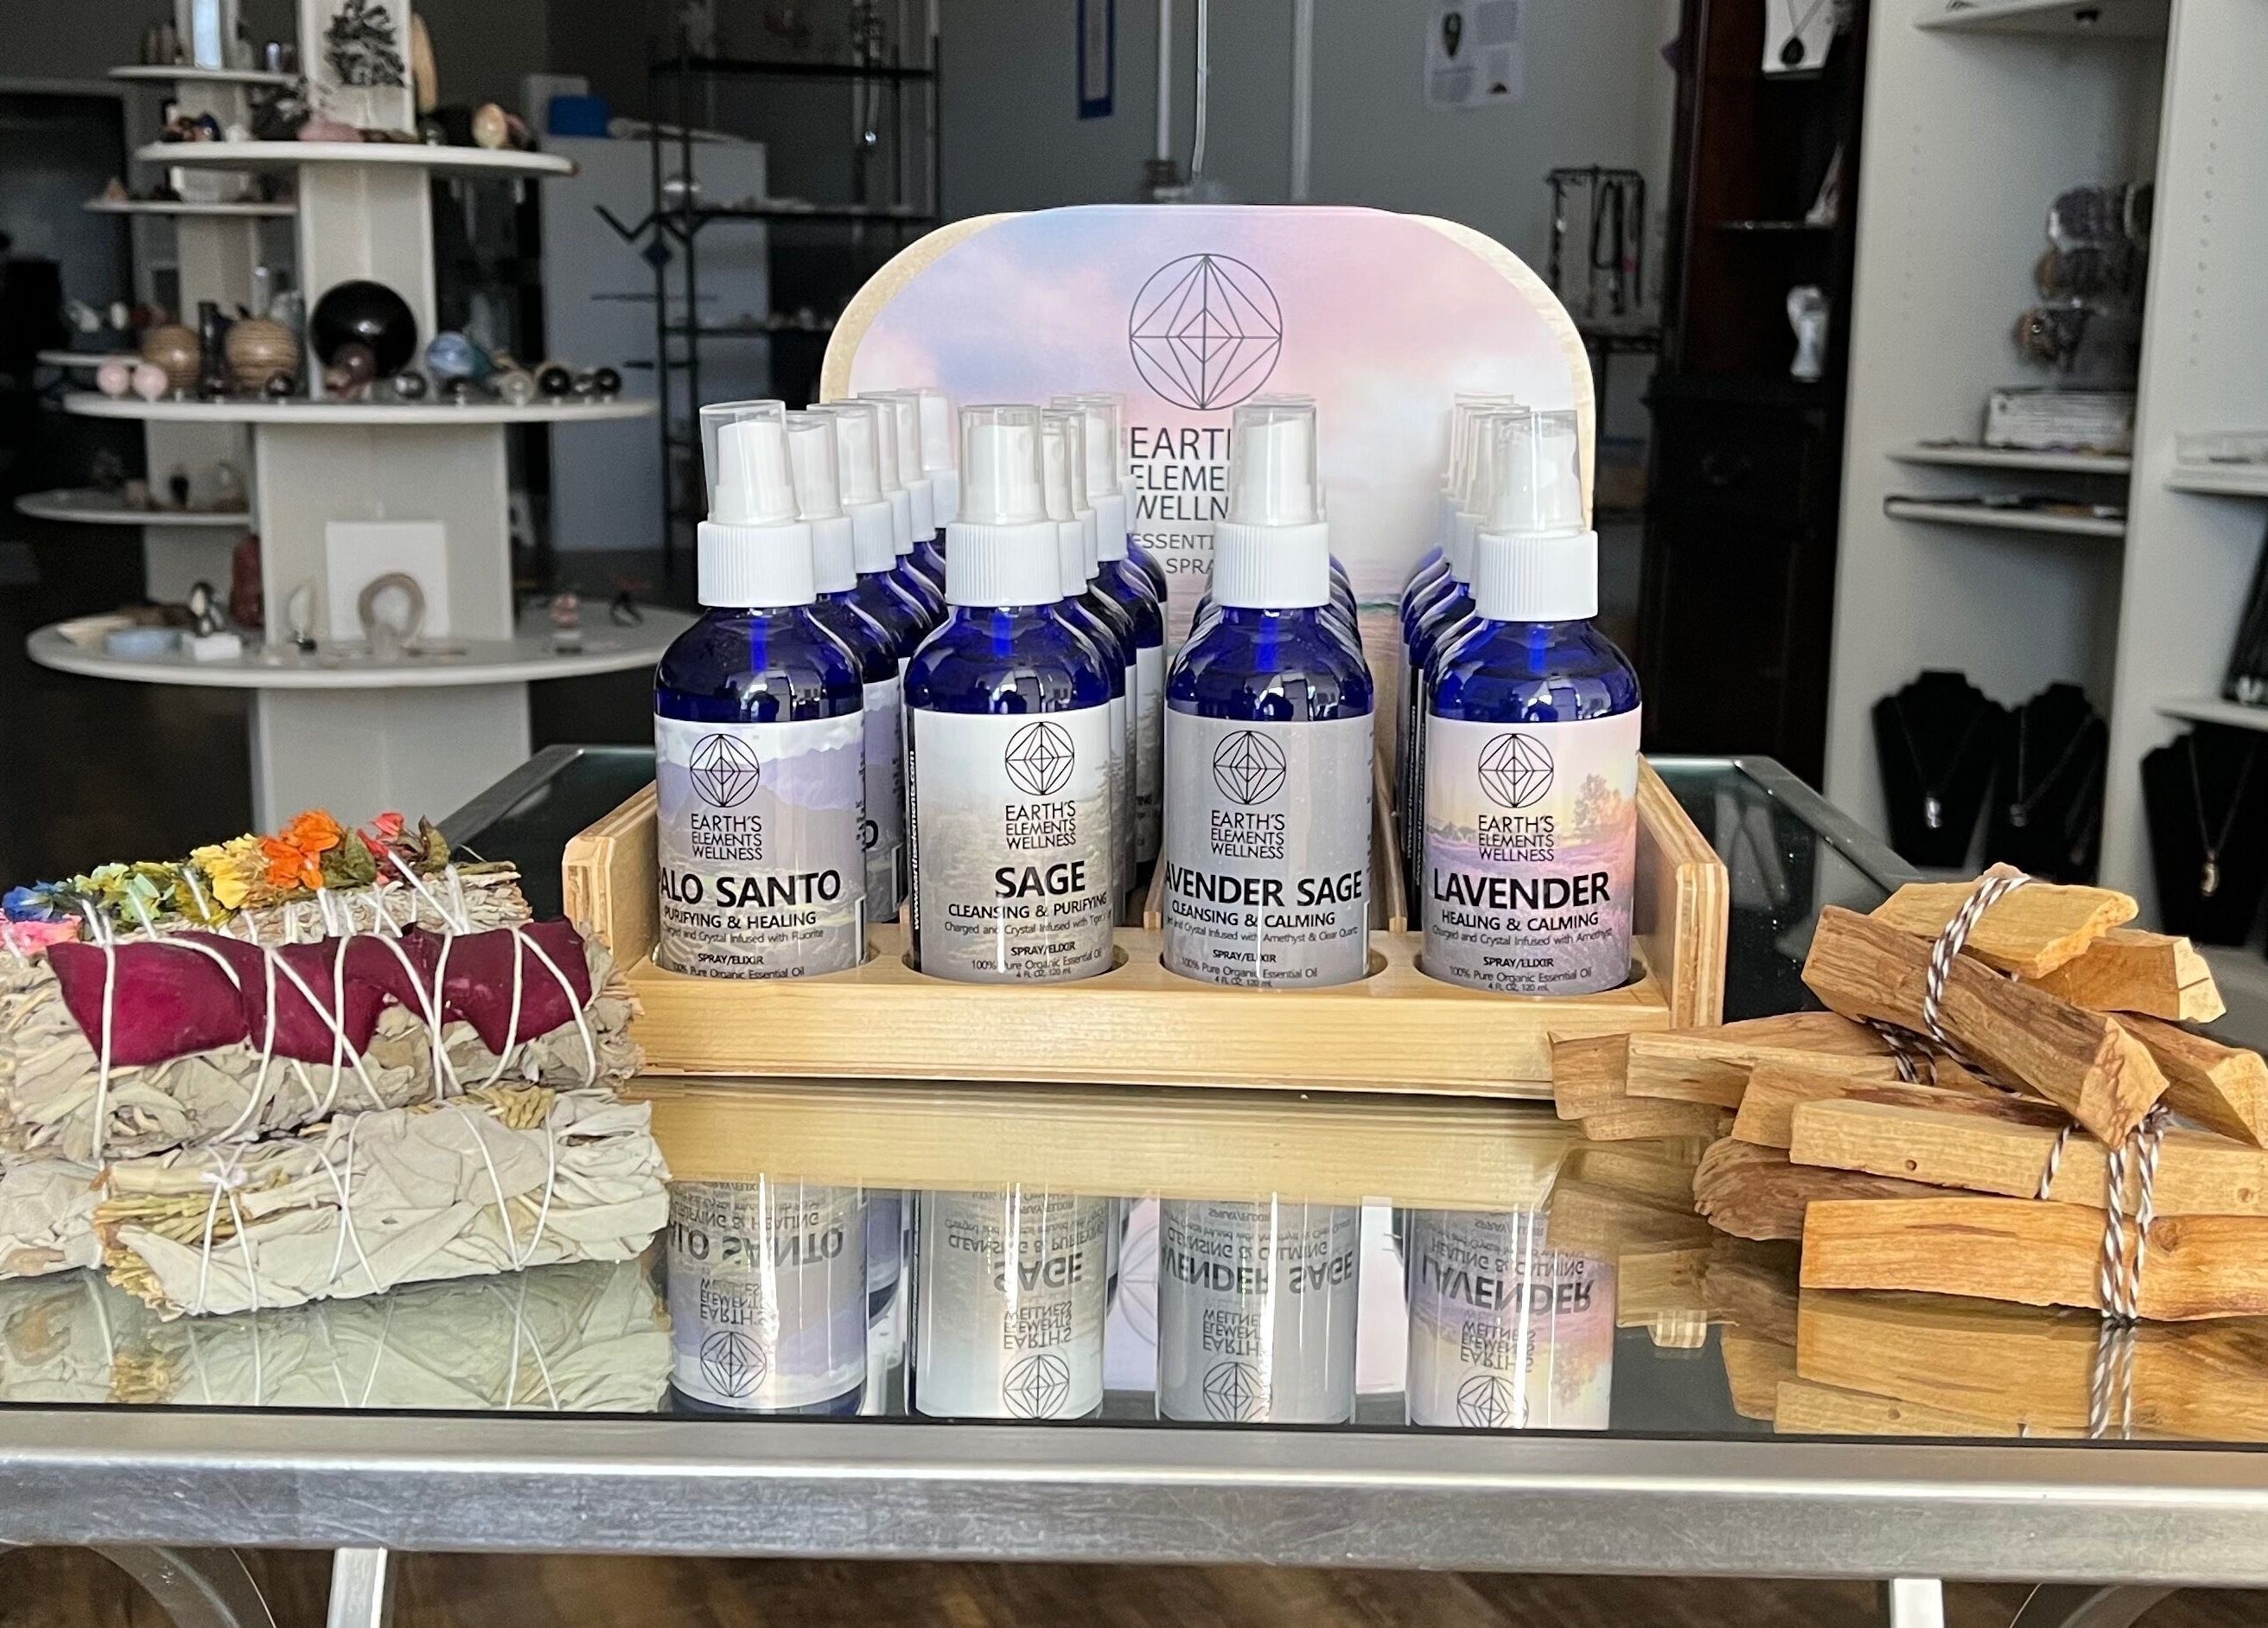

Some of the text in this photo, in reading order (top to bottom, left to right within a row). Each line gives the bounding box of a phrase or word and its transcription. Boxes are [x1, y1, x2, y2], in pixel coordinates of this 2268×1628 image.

[1131, 426, 1231, 461] EART
[1131, 464, 1229, 492] ELEME
[1005, 800, 1076, 821] EARTH'S
[691, 813, 762, 833] EARTH'S
[1005, 819, 1076, 836] ELEMENTS
[1211, 809, 1285, 832] EARTH'S
[1478, 814, 1554, 833] EARTH'S
[691, 832, 762, 846] ELEMENTS
[1006, 833, 1077, 851] WELLNESS
[1211, 829, 1284, 846] ELEMENTS
[1478, 833, 1554, 848] ELEMENTS
[692, 845, 763, 861] WELLNESS
[1211, 842, 1284, 859] WELLNESS
[1479, 846, 1554, 863] WELLNESS
[716, 869, 841, 908] SANTO
[995, 860, 1086, 899] SAGE
[1296, 870, 1362, 907] SAGE
[1433, 868, 1611, 910] LAVENDER
[948, 903, 1030, 919] CLEANSING
[1035, 904, 1048, 917] &
[1054, 891, 1107, 916] PURIFYING
[1172, 900, 1239, 926] CLEANSING
[1244, 914, 1258, 928] &
[1265, 912, 1335, 928] CALMING
[665, 906, 817, 929] PURIFYING & HEALING
[1443, 909, 1599, 931] HEALING & CALMING
[698, 931, 727, 945] Crystal
[729, 932, 764, 943] Infused
[768, 932, 789, 942] with
[945, 921, 979, 935] Charged
[1004, 925, 1035, 938] Crystal
[1040, 920, 1070, 933] Infused
[1185, 922, 1207, 935] Crystal
[1208, 928, 1238, 941] Infused
[1263, 931, 1305, 945] Amethyst
[1319, 931, 1337, 942] Clear
[1010, 941, 1076, 956] SPRAY/ELIXIR
[1462, 932, 1477, 943] and
[1481, 934, 1511, 948] Crystal
[1514, 935, 1550, 947] Infused
[1553, 934, 1573, 945] with
[698, 953, 764, 965] SPRAY/ELIXIR
[972, 960, 997, 970] 100%
[1025, 957, 1060, 972] Organic
[1213, 949, 1277, 962] SPRAY/ELXIR
[1483, 956, 1554, 968] SPRAY/ELIXIR
[690, 966, 707, 978] Pure
[749, 967, 788, 980] Essential
[792, 966, 806, 977] Oil
[1201, 962, 1220, 974] Pure
[1263, 968, 1303, 979] Essential
[1305, 967, 1318, 978] Oil
[1449, 965, 1592, 986] 100% Pure Organic Essential Oil
